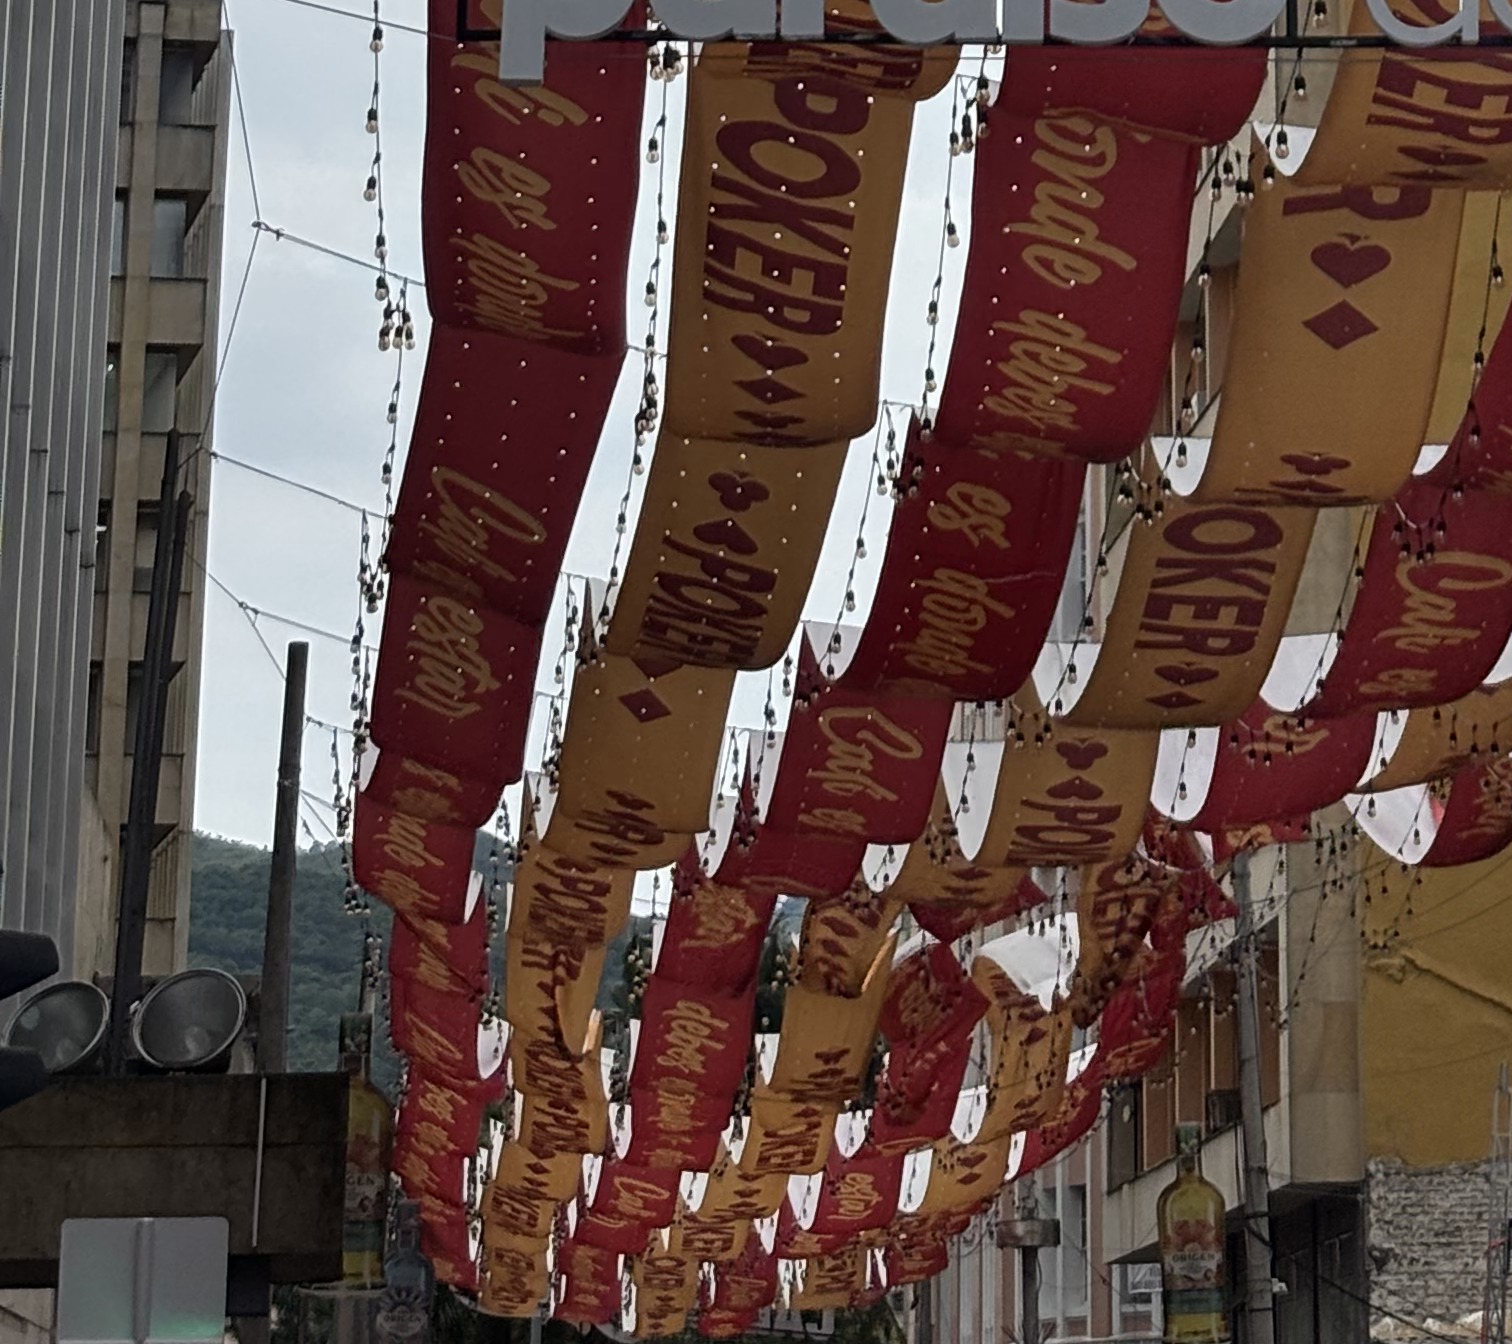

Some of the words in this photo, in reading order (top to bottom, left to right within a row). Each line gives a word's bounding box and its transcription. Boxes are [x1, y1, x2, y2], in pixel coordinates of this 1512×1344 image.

[457, 145, 559, 231] es
[702, 77, 874, 337] POKER
[1003, 109, 1137, 288] onde
[448, 232, 582, 340] dond
[927, 480, 1016, 551] es
[1135, 511, 1284, 656] OKER
[393, 595, 503, 720] estar
[805, 706, 925, 803] Cali
[1004, 797, 1123, 865] POK
